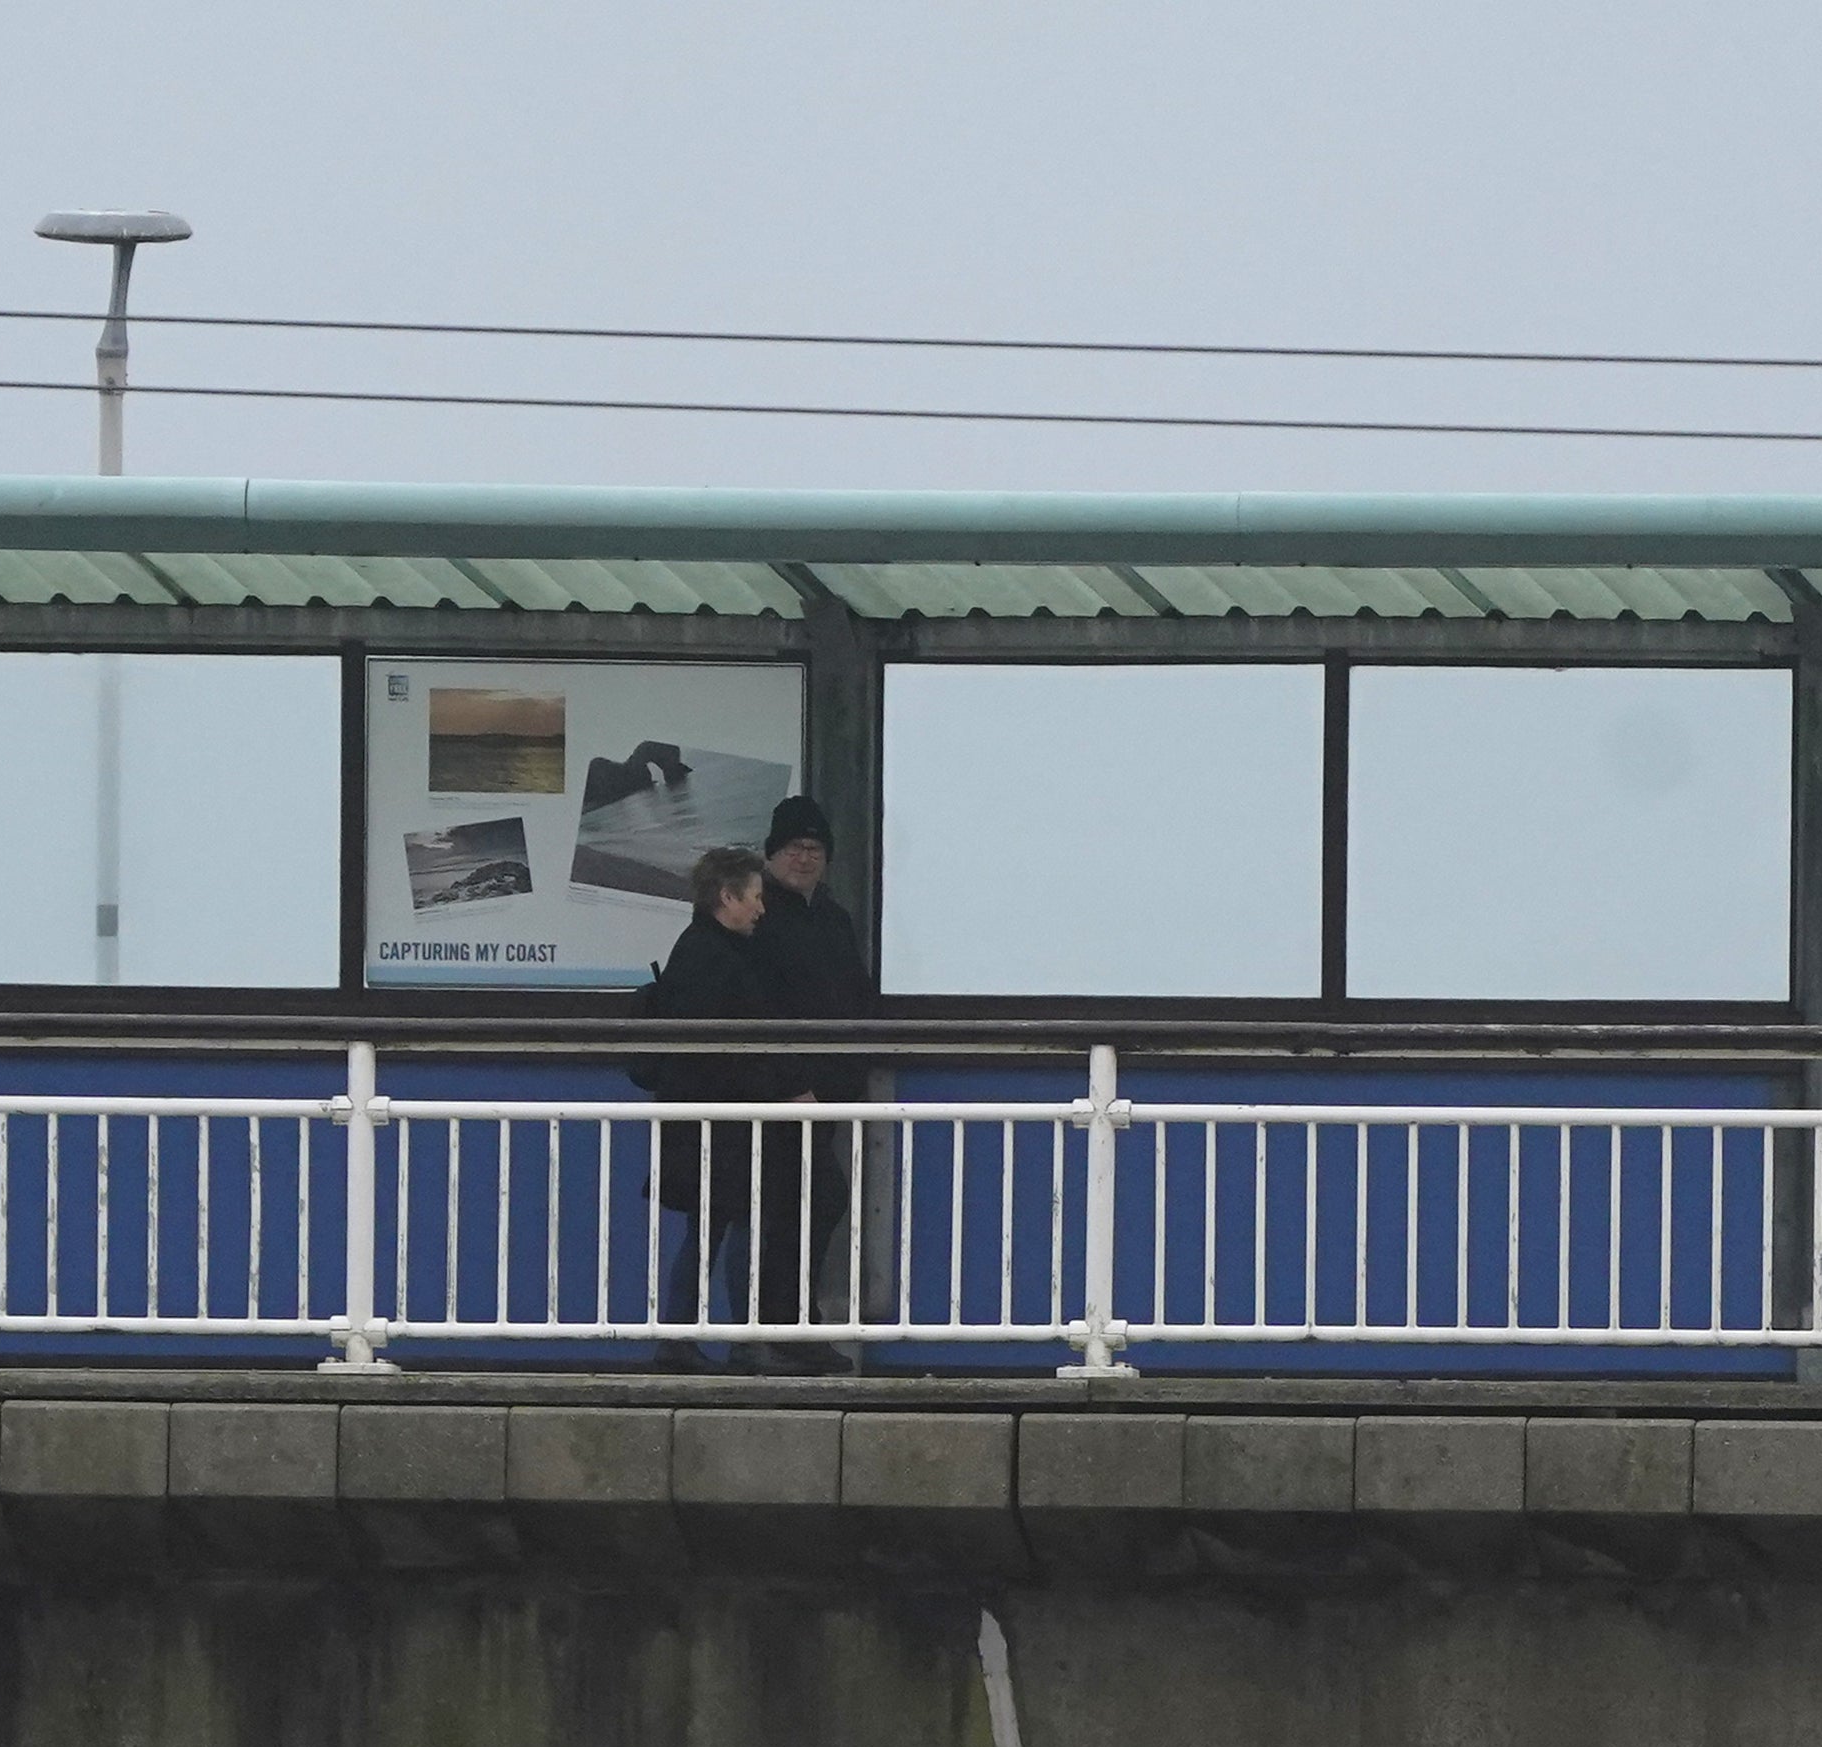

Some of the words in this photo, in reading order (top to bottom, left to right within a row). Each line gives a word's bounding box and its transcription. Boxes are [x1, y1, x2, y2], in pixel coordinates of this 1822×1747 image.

[380, 942, 469, 961] CAPTURING
[476, 944, 500, 962] MY
[506, 944, 557, 963] COAST
